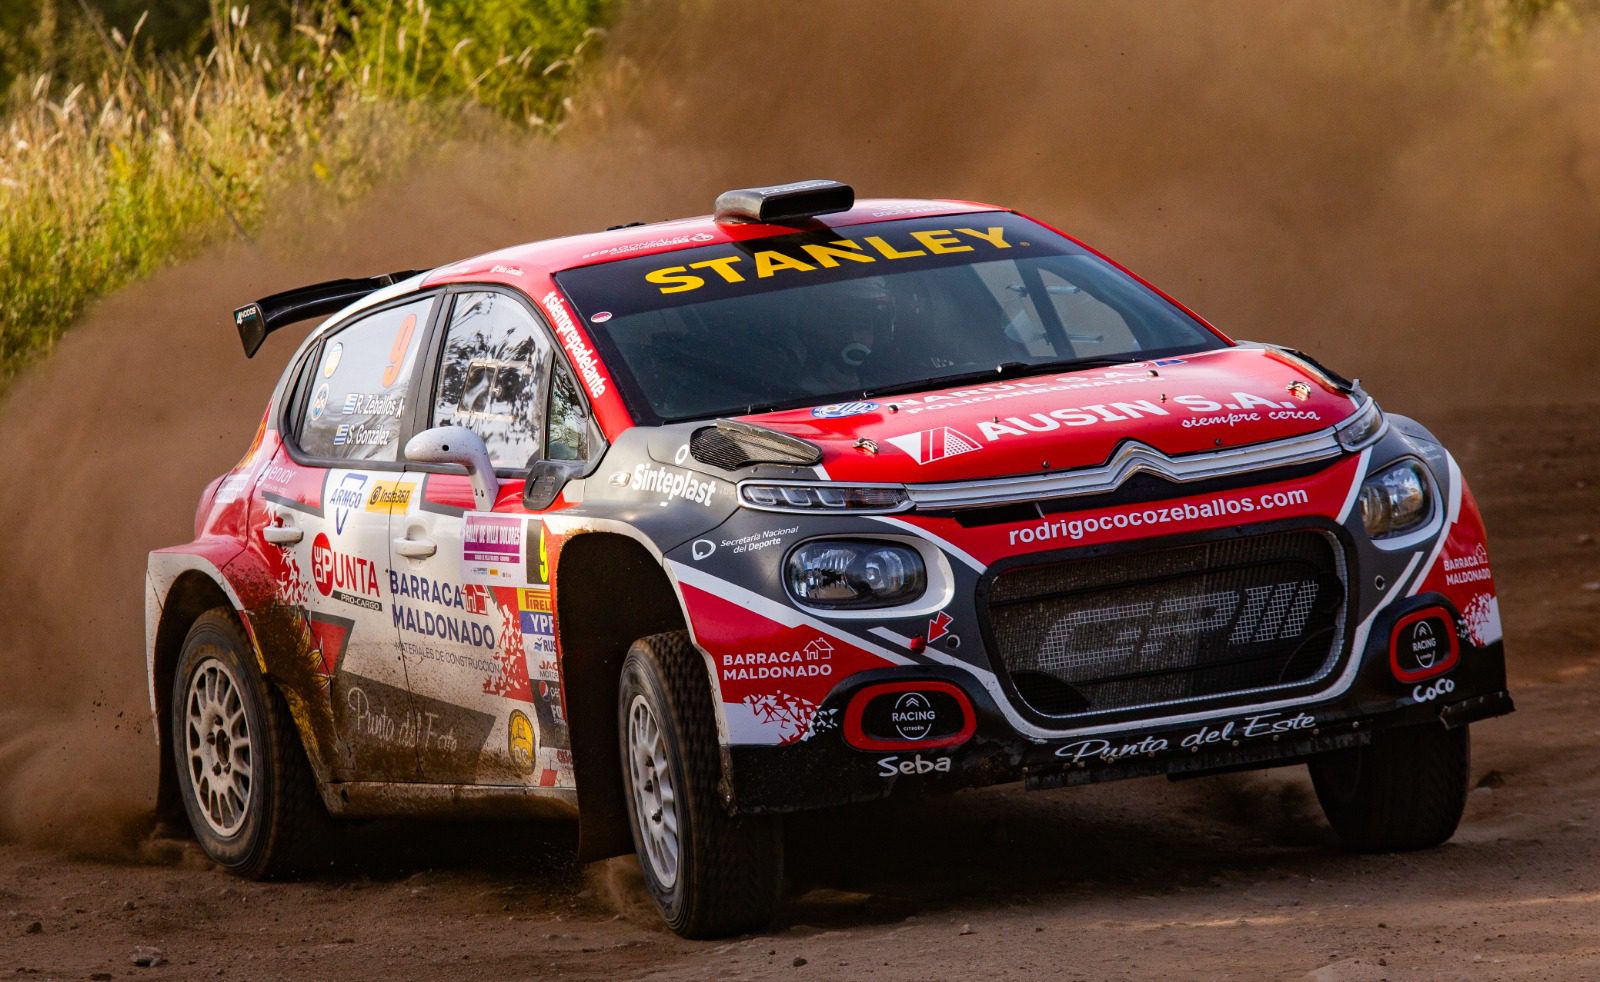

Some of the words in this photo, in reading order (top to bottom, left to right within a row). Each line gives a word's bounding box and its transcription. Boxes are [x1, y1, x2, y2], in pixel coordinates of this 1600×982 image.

[645, 226, 1012, 294] STANLEY
[382, 313, 417, 388] 9
[975, 398, 1170, 442] AUSIN
[1173, 391, 1297, 412] S.A.
[1181, 411, 1261, 428] siempre
[1268, 409, 1321, 421] cerca
[346, 425, 355, 445] S.
[632, 463, 716, 507] Sinteplast
[329, 487, 363, 509] ARMCO
[1009, 488, 1309, 546] rodrigococozeballos.com
[762, 525, 799, 539] Nacional
[733, 544, 747, 554] del
[748, 537, 781, 551] Deporte
[322, 547, 380, 598] PUNTA
[1443, 554, 1480, 572] BARRACA
[1446, 566, 1492, 586] MALDONADO
[389, 569, 465, 611] BARRACA
[340, 593, 380, 610] PRO-CARGO
[392, 603, 495, 650] MALDONADO
[1412, 637, 1437, 652] RACING
[723, 651, 802, 666] BARRACA
[723, 664, 832, 681] MALDONADO
[892, 710, 936, 722] RACING
[1055, 736, 1169, 763] Punta
[1181, 726, 1232, 749] del
[1243, 712, 1317, 738] Este
[877, 754, 952, 777] Seba
